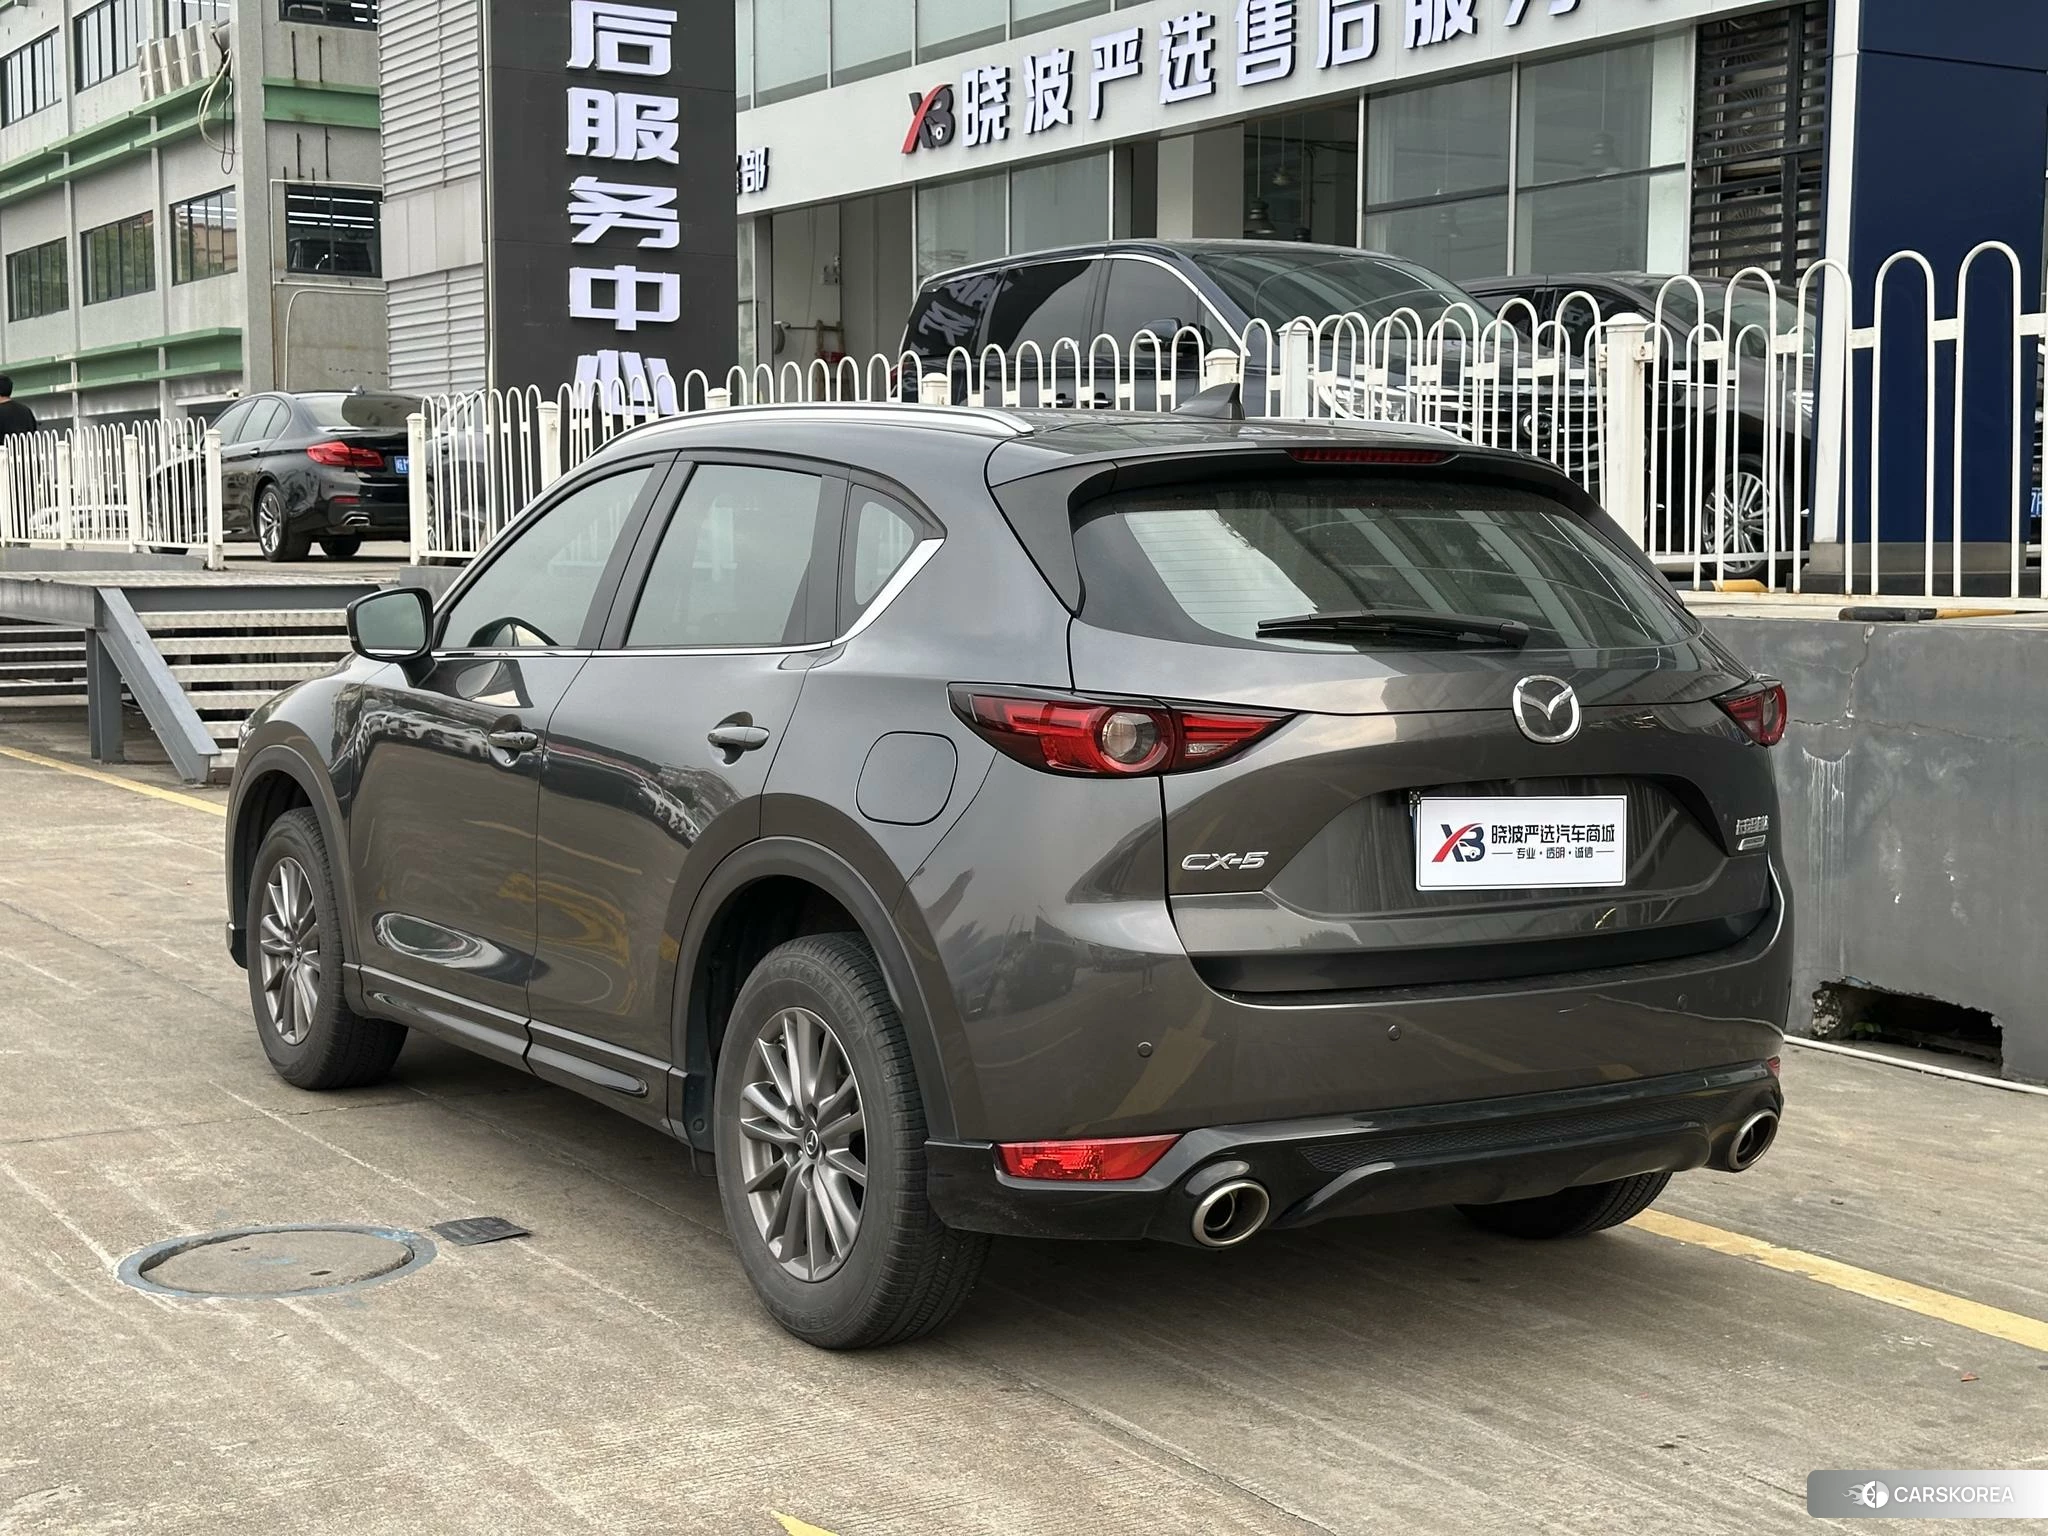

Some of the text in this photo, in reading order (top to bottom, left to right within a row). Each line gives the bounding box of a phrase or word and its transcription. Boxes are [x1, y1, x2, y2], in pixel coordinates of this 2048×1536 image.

[961, 0, 1580, 148] 晓波严选售后服
[738, 147, 769, 194] 部
[1491, 824, 1615, 844] 晓波严选汽车商城
[1181, 851, 1269, 871] CX-5
